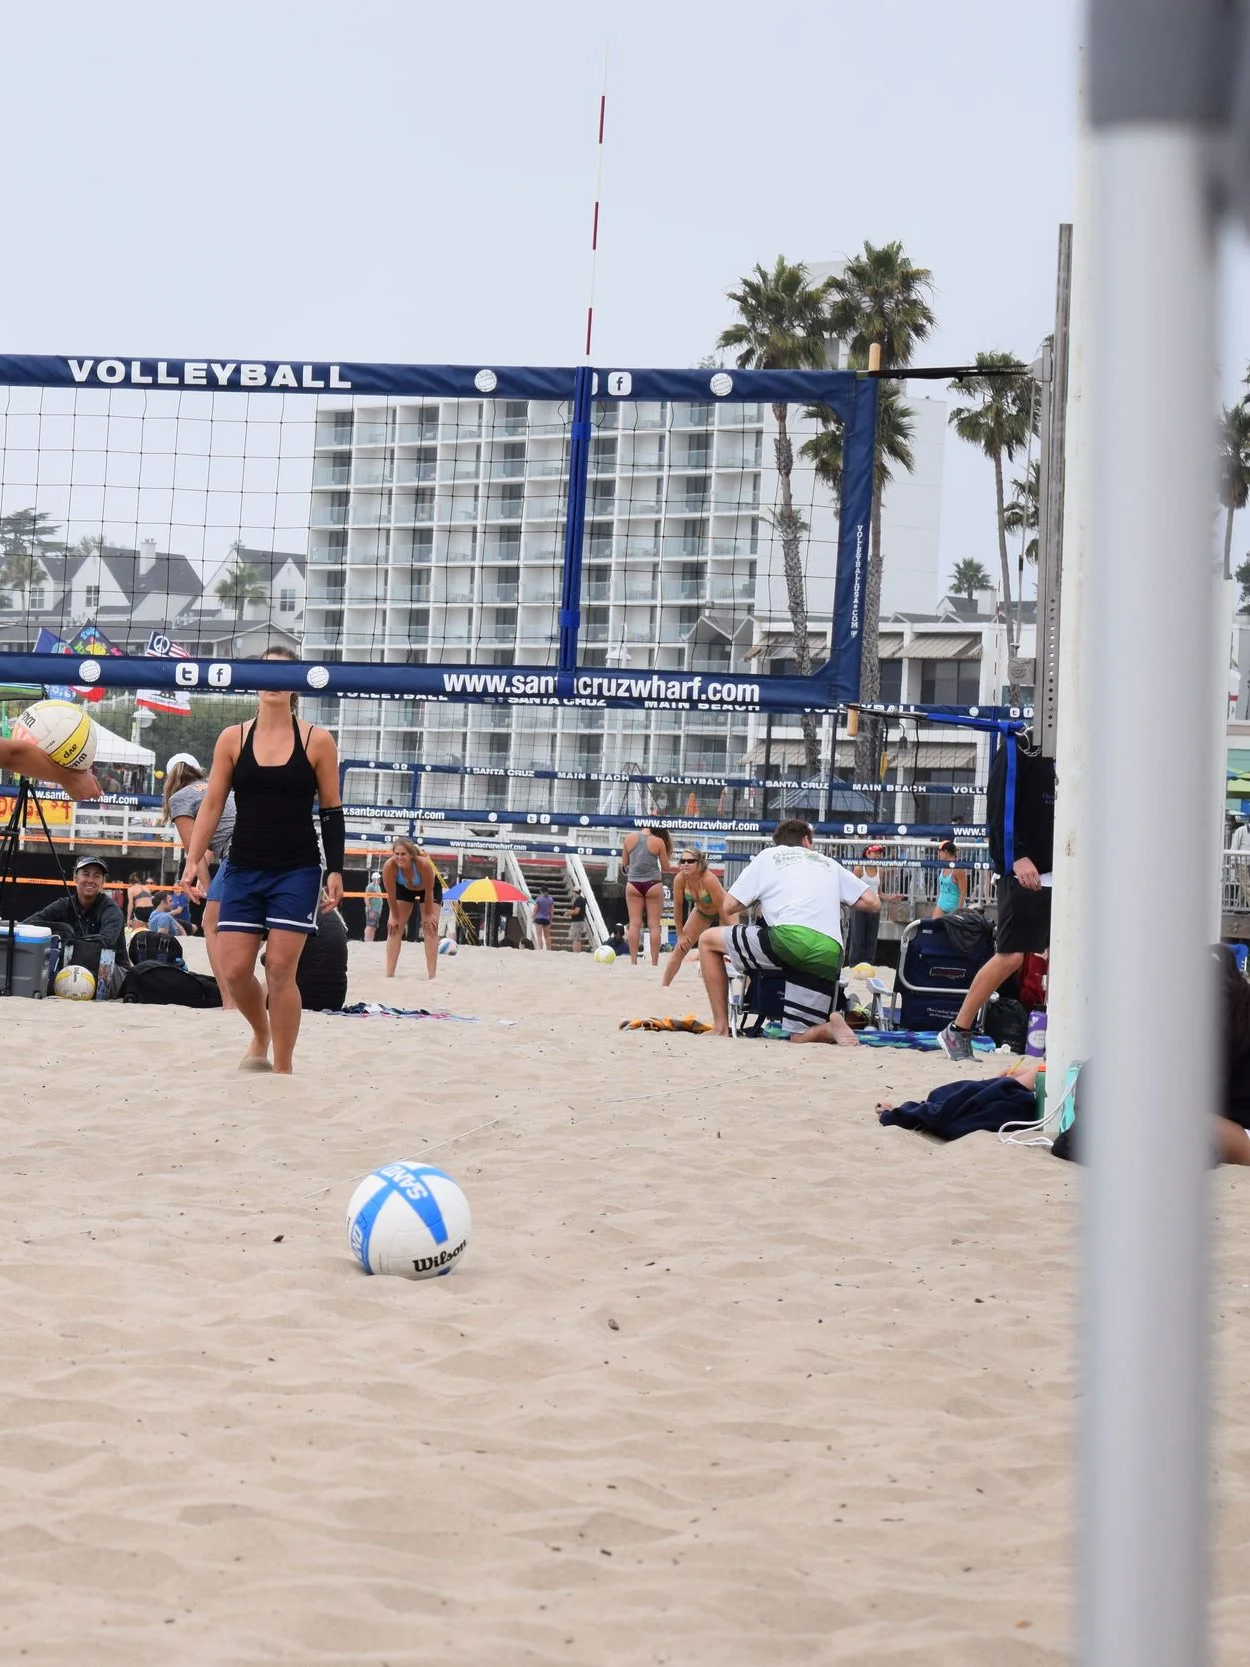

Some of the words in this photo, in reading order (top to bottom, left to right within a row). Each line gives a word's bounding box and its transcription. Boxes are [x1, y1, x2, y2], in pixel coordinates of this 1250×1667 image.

[67, 359, 351, 389] VOLLEYBALL
[443, 673, 760, 703] www.sancruzwharf.com
[656, 777, 727, 786] VOLLEYBALL
[634, 818, 759, 832] www.santacruzwharf.com
[450, 840, 527, 851] www.santacruzwharf.com
[842, 859, 921, 868] www.santacruzwharf.com
[412, 1240, 467, 1272] Wilson
